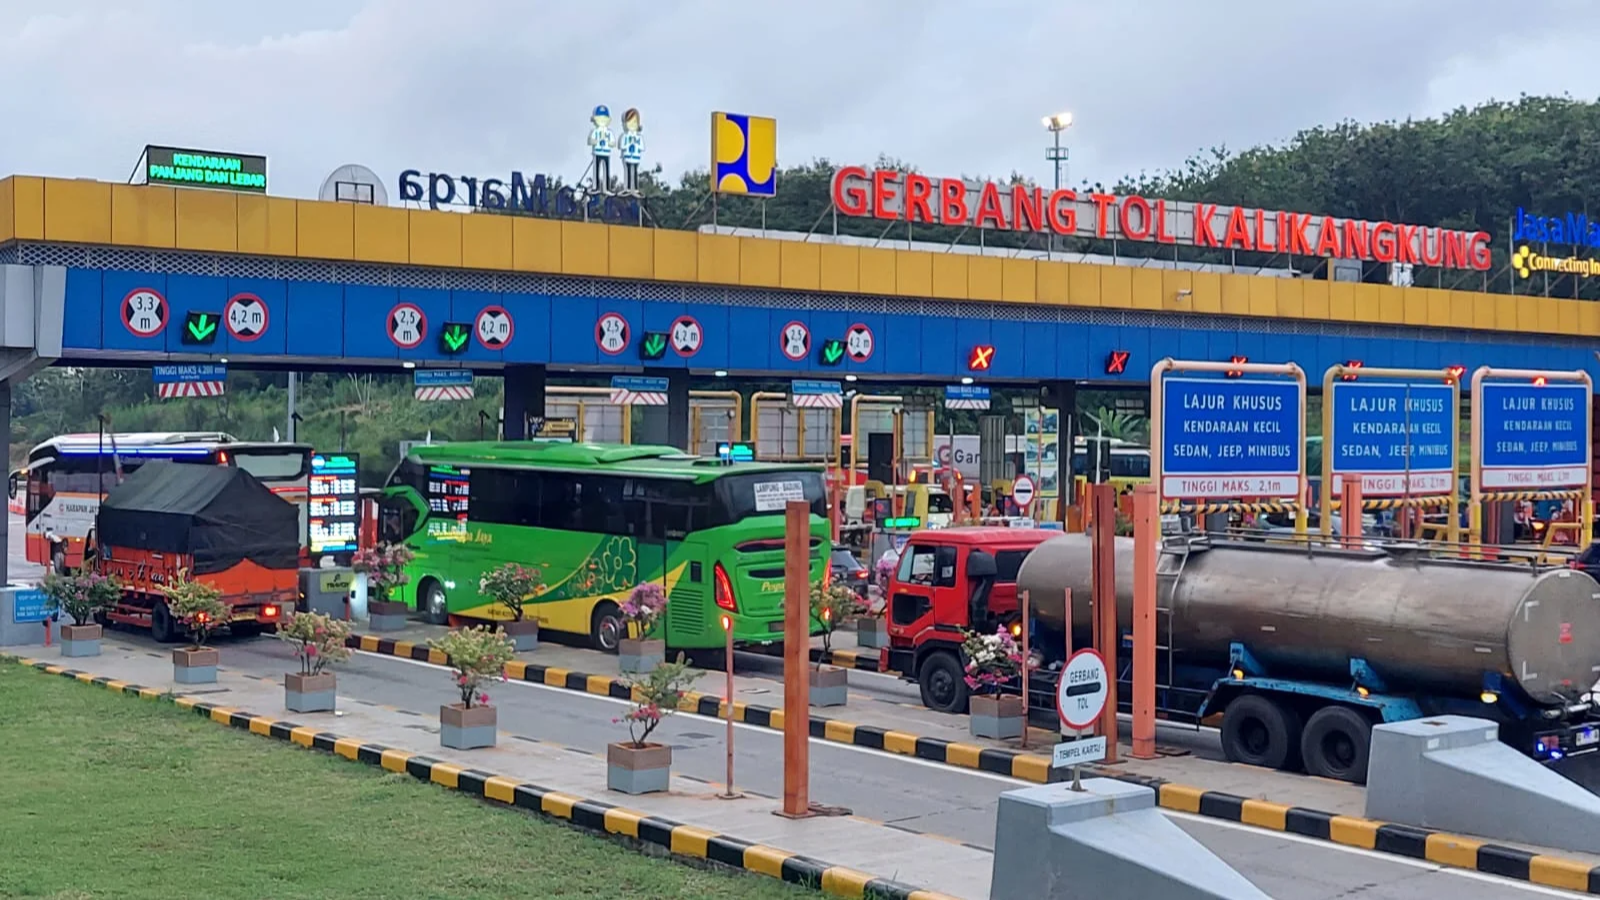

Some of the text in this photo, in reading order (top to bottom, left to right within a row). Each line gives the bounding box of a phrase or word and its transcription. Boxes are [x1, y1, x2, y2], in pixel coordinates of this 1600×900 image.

[173, 153, 241, 171] KENDARAAN
[150, 165, 265, 187] PANJANG DAN LEBAR
[832, 166, 1492, 271] GERBANG TOL KALIKANGKUNG
[136, 296, 154, 312] 3,3
[140, 317, 151, 329] m
[230, 310, 262, 325] 4,2 m
[400, 310, 415, 326] 2,5
[481, 321, 508, 335] 4,2 m
[606, 320, 620, 334] 2,5
[403, 330, 412, 342] m
[609, 337, 617, 348] m
[674, 330, 698, 343] 4,2 m
[1183, 393, 1282, 411] LAJUR KHUSUS
[1351, 397, 1444, 412] LAJUR KHUSUS
[1502, 397, 1574, 411] LAJUR KHUSUS
[1184, 420, 1281, 433] KENDARAAN KECIL
[1352, 422, 1441, 434] KENDARAAN KECIL
[1503, 420, 1572, 431] KENDARAAN KECIL
[1173, 444, 1291, 459] SEDAN, JEEP, MINIBUS
[1341, 444, 1381, 458] SEDAN,
[1418, 444, 1448, 456] MINIBUS
[1496, 441, 1527, 454] SEDAN,
[1552, 440, 1578, 451] MINIBUS
[1182, 480, 1281, 493] TINGGI MAKS. 2,1m
[1363, 478, 1396, 490] INGGI
[1069, 667, 1099, 684] GERBANG
[1077, 697, 1089, 710] TOL
